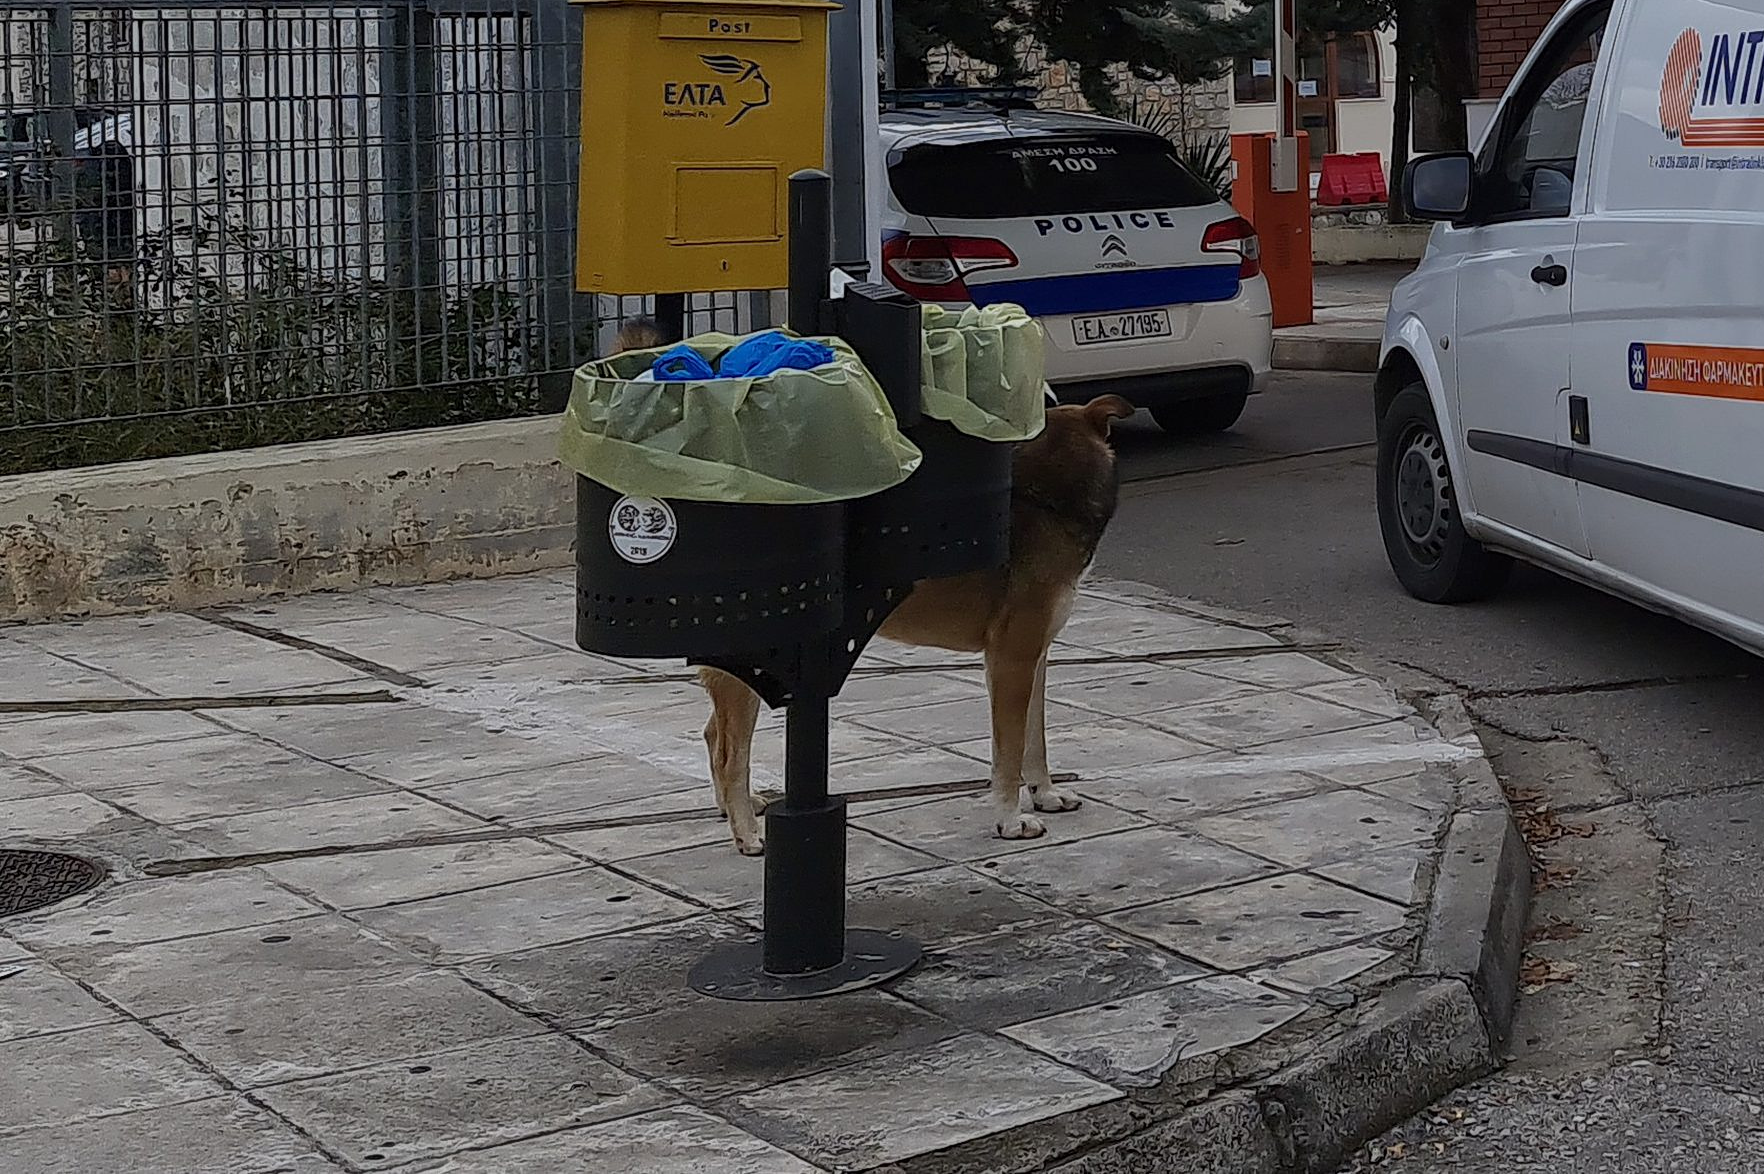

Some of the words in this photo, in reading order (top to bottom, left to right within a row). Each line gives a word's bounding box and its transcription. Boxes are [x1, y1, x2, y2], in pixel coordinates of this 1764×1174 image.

[708, 18, 750, 34] Post
[664, 83, 726, 106] ΕΛΤΑ
[1049, 158, 1097, 172] 100
[1034, 212, 1174, 236] POLICE
[1650, 357, 1700, 382] ΔΙΑΚΙΝΗΣΗ
